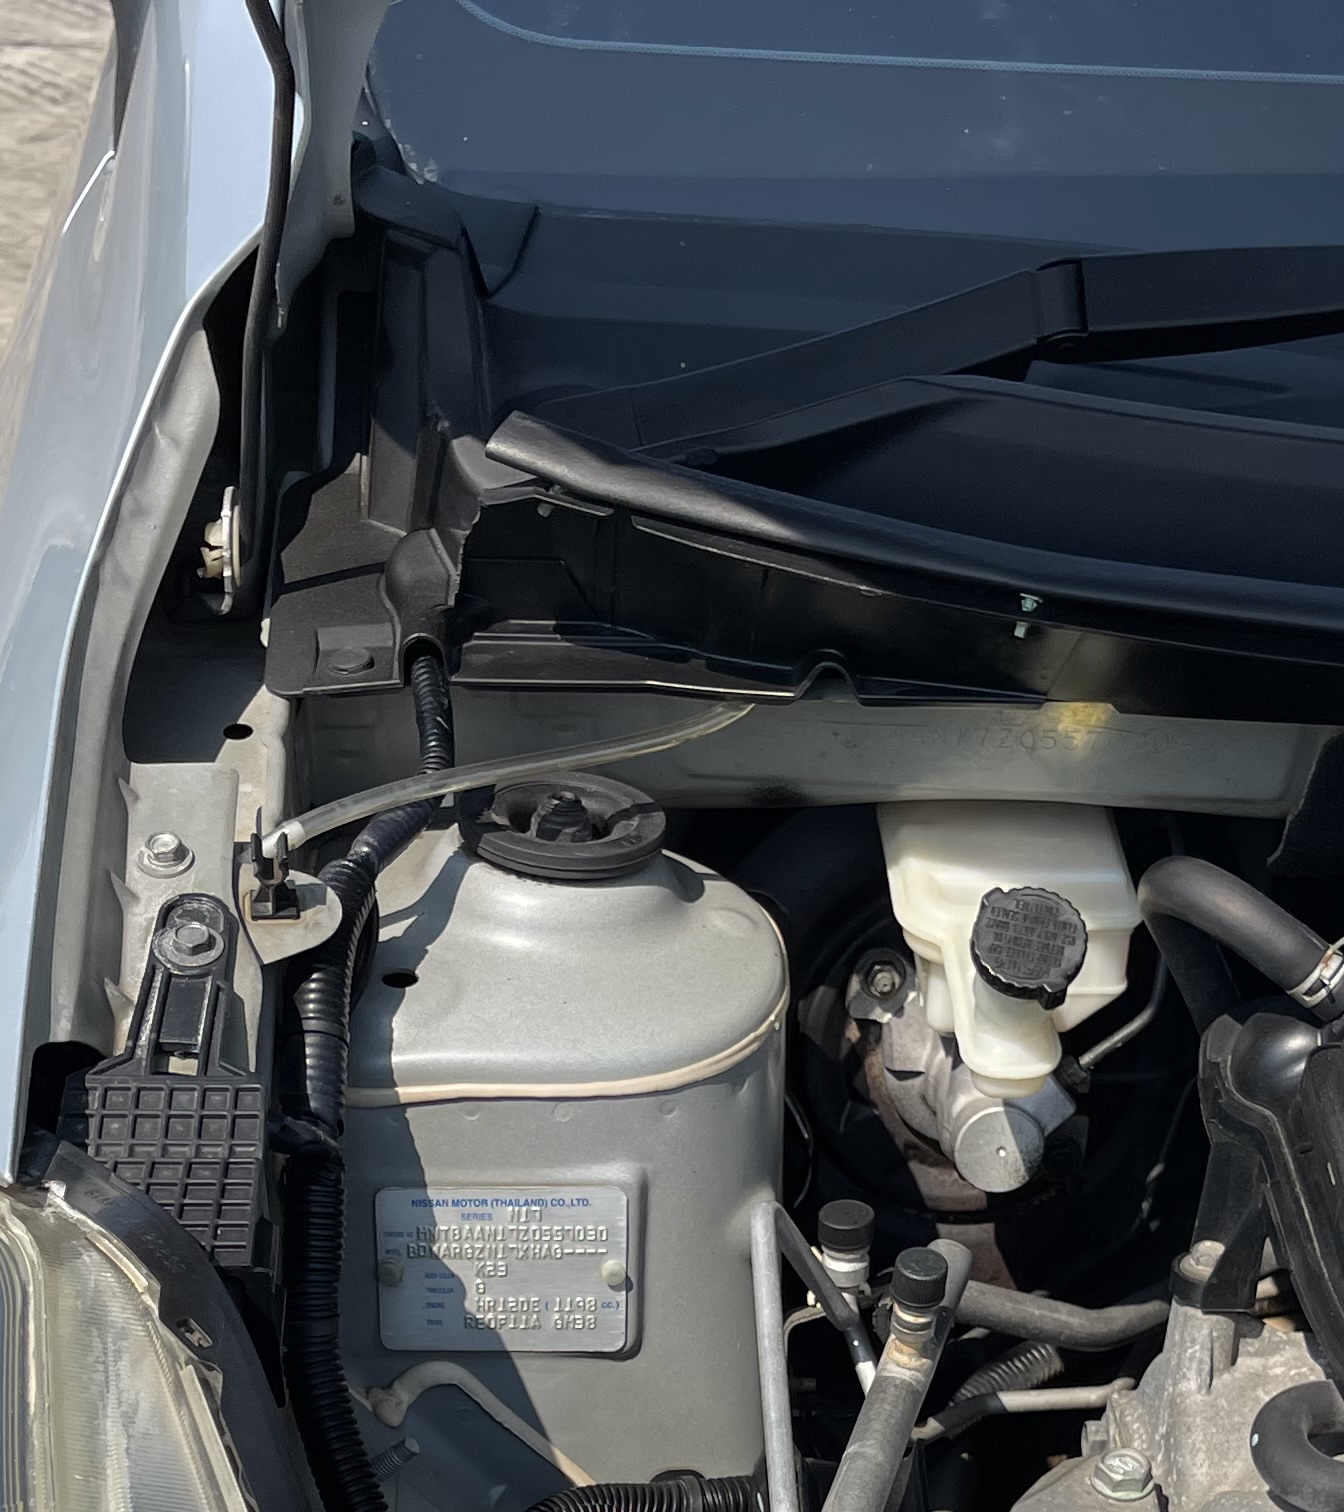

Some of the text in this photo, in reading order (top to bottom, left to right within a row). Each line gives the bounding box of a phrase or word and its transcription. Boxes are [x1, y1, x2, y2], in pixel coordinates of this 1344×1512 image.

[411, 1199, 449, 1209] NISSAN
[452, 1199, 488, 1208] MOTOR
[490, 1198, 548, 1209] (THAILAND)
[460, 1206, 543, 1223] SERIES N17
